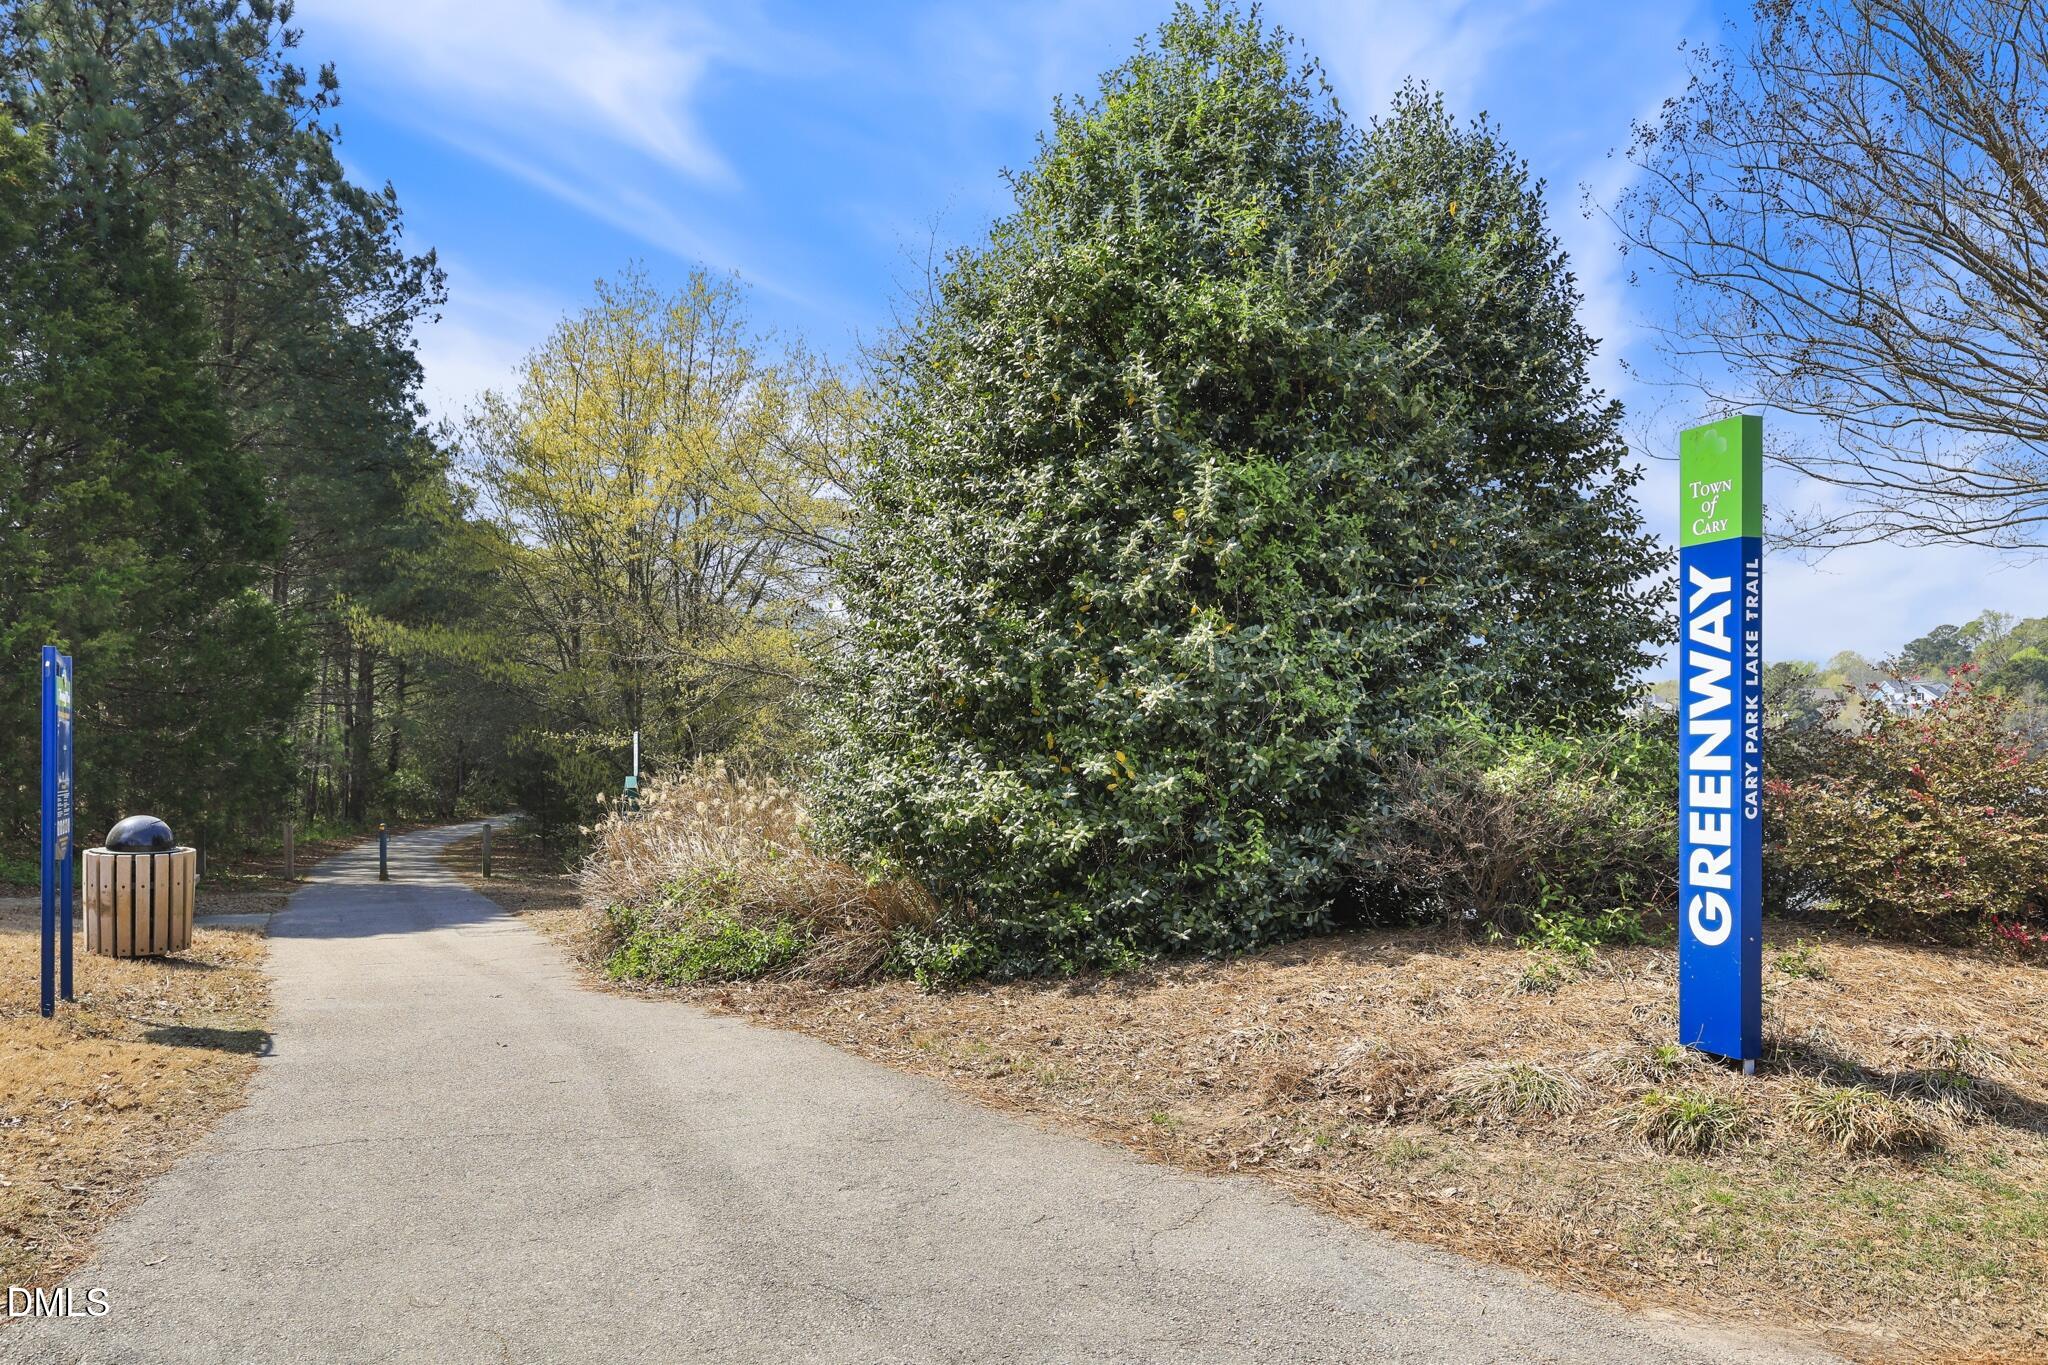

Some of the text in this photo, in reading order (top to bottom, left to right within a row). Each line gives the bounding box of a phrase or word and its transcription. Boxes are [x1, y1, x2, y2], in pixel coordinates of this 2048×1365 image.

[1701, 495, 1719, 519] of
[1688, 565, 1732, 946] GREENWAY
[1745, 558, 1759, 820] CARY PARK LAKE TRAIL
